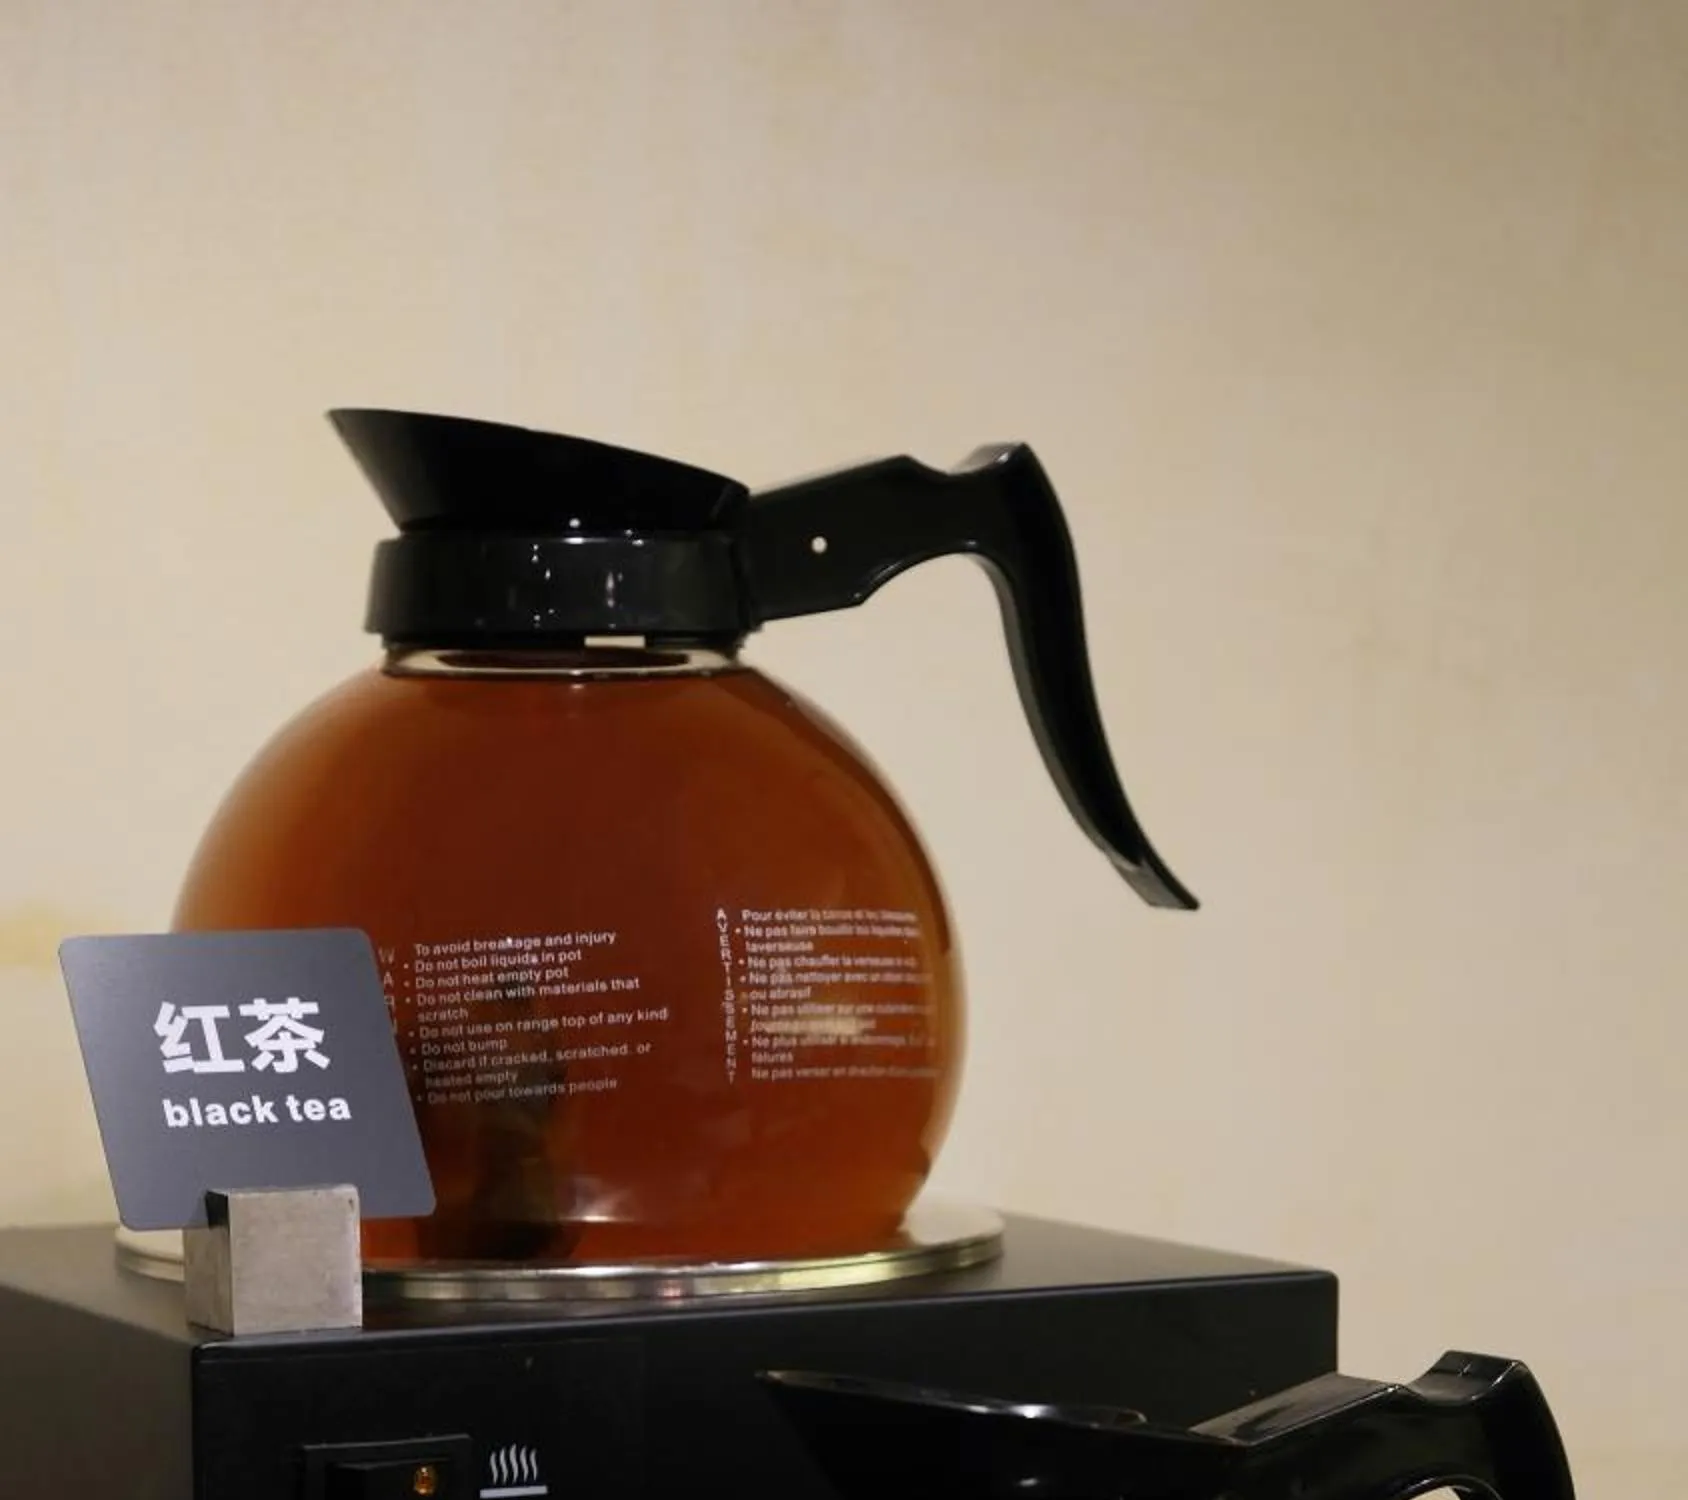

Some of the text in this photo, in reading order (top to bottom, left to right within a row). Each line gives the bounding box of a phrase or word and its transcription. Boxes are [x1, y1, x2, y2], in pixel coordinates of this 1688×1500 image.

[741, 909, 772, 922] Pour
[415, 931, 617, 957] To avoid breakage and injury
[744, 925, 763, 937] Ne
[765, 926, 788, 939] pas
[415, 949, 582, 973] Do not boil liquids in pot
[748, 957, 767, 969] Ne
[415, 966, 569, 990] Do not heat empty pot
[749, 971, 768, 984] Ne
[416, 976, 641, 1007] Do not clean with materials that
[417, 1008, 469, 1023] scratch
[419, 1007, 669, 1040] Do not use on range top of any kind
[153, 997, 331, 1074] 红茶
[421, 1037, 508, 1056] Do not bump
[423, 1055, 476, 1073] Discard
[478, 1054, 489, 1069] if
[637, 1041, 653, 1055] or
[569, 1077, 618, 1096] people
[163, 1095, 352, 1128] black tea
